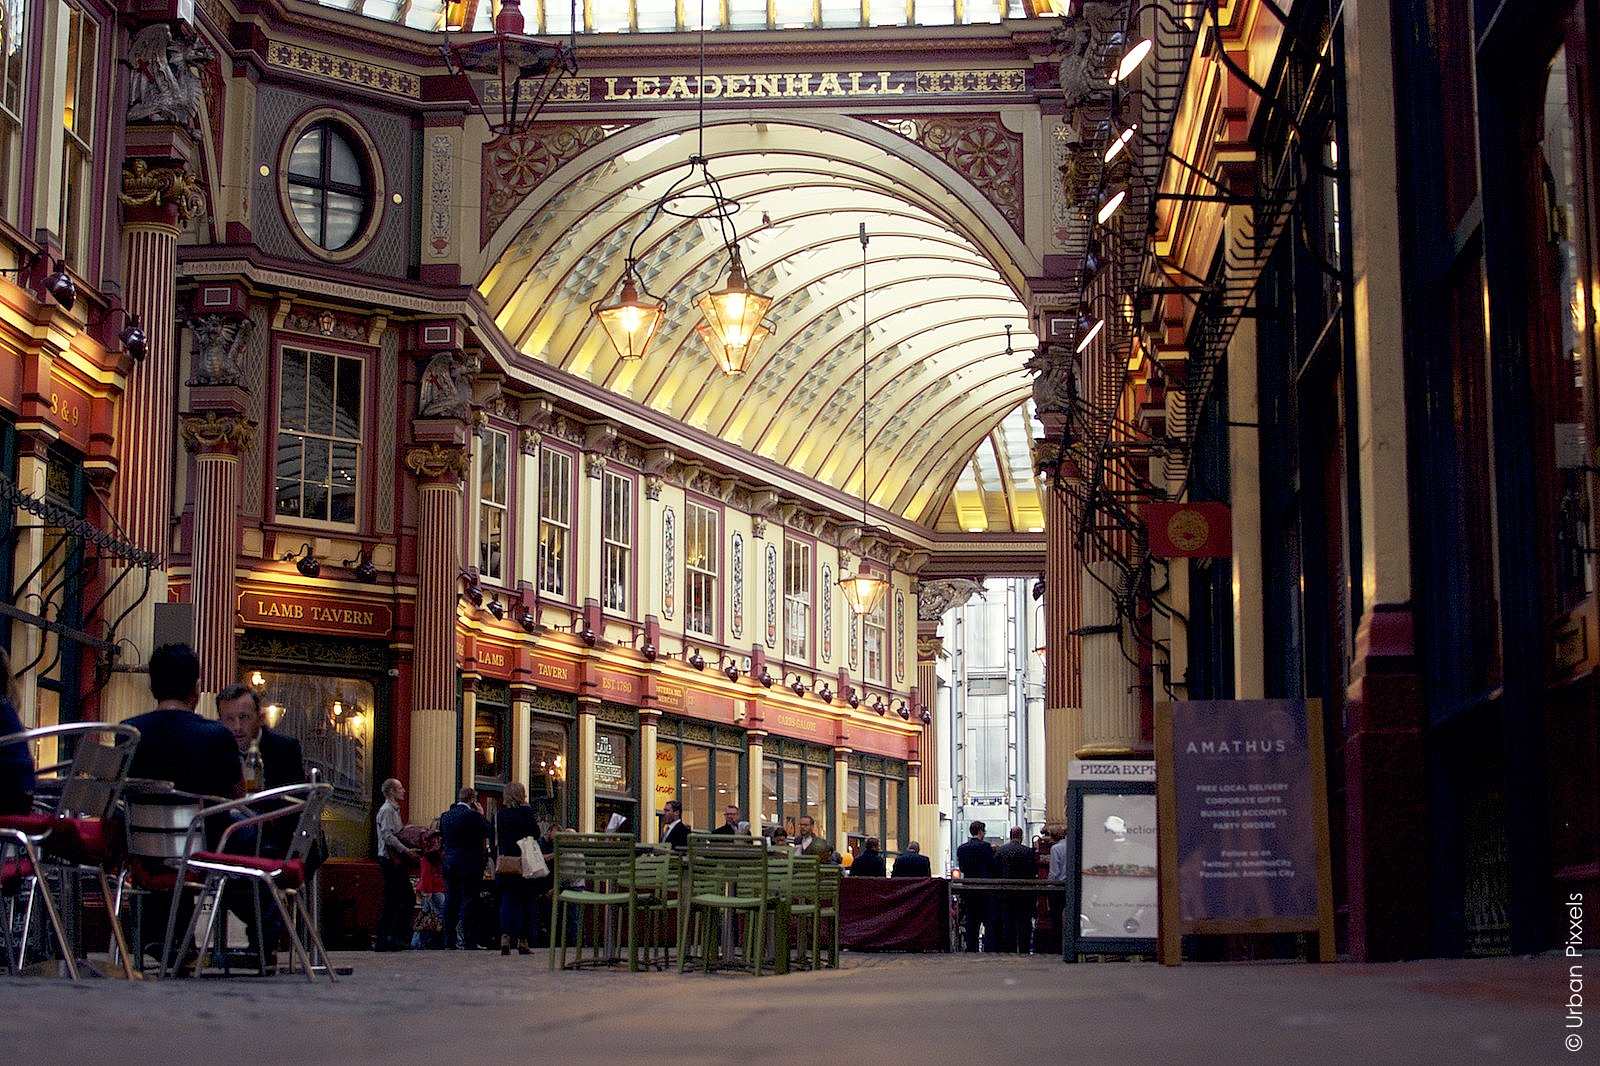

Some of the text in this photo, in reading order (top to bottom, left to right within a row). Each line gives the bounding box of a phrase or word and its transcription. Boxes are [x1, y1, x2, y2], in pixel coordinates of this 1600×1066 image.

[604, 71, 904, 100] LEADENHALL
[258, 601, 374, 625] LAMB TAVERN
[478, 651, 505, 667] LAMB
[538, 663, 568, 680] TAVERN
[1186, 740, 1286, 754] AMATHUS
[1080, 764, 1120, 775] PIZZA
[1196, 783, 1288, 792] FREE LOCAL DELIVERY
[1257, 796, 1282, 804] GIFTS
[1242, 808, 1287, 817] ACCOUNTS
